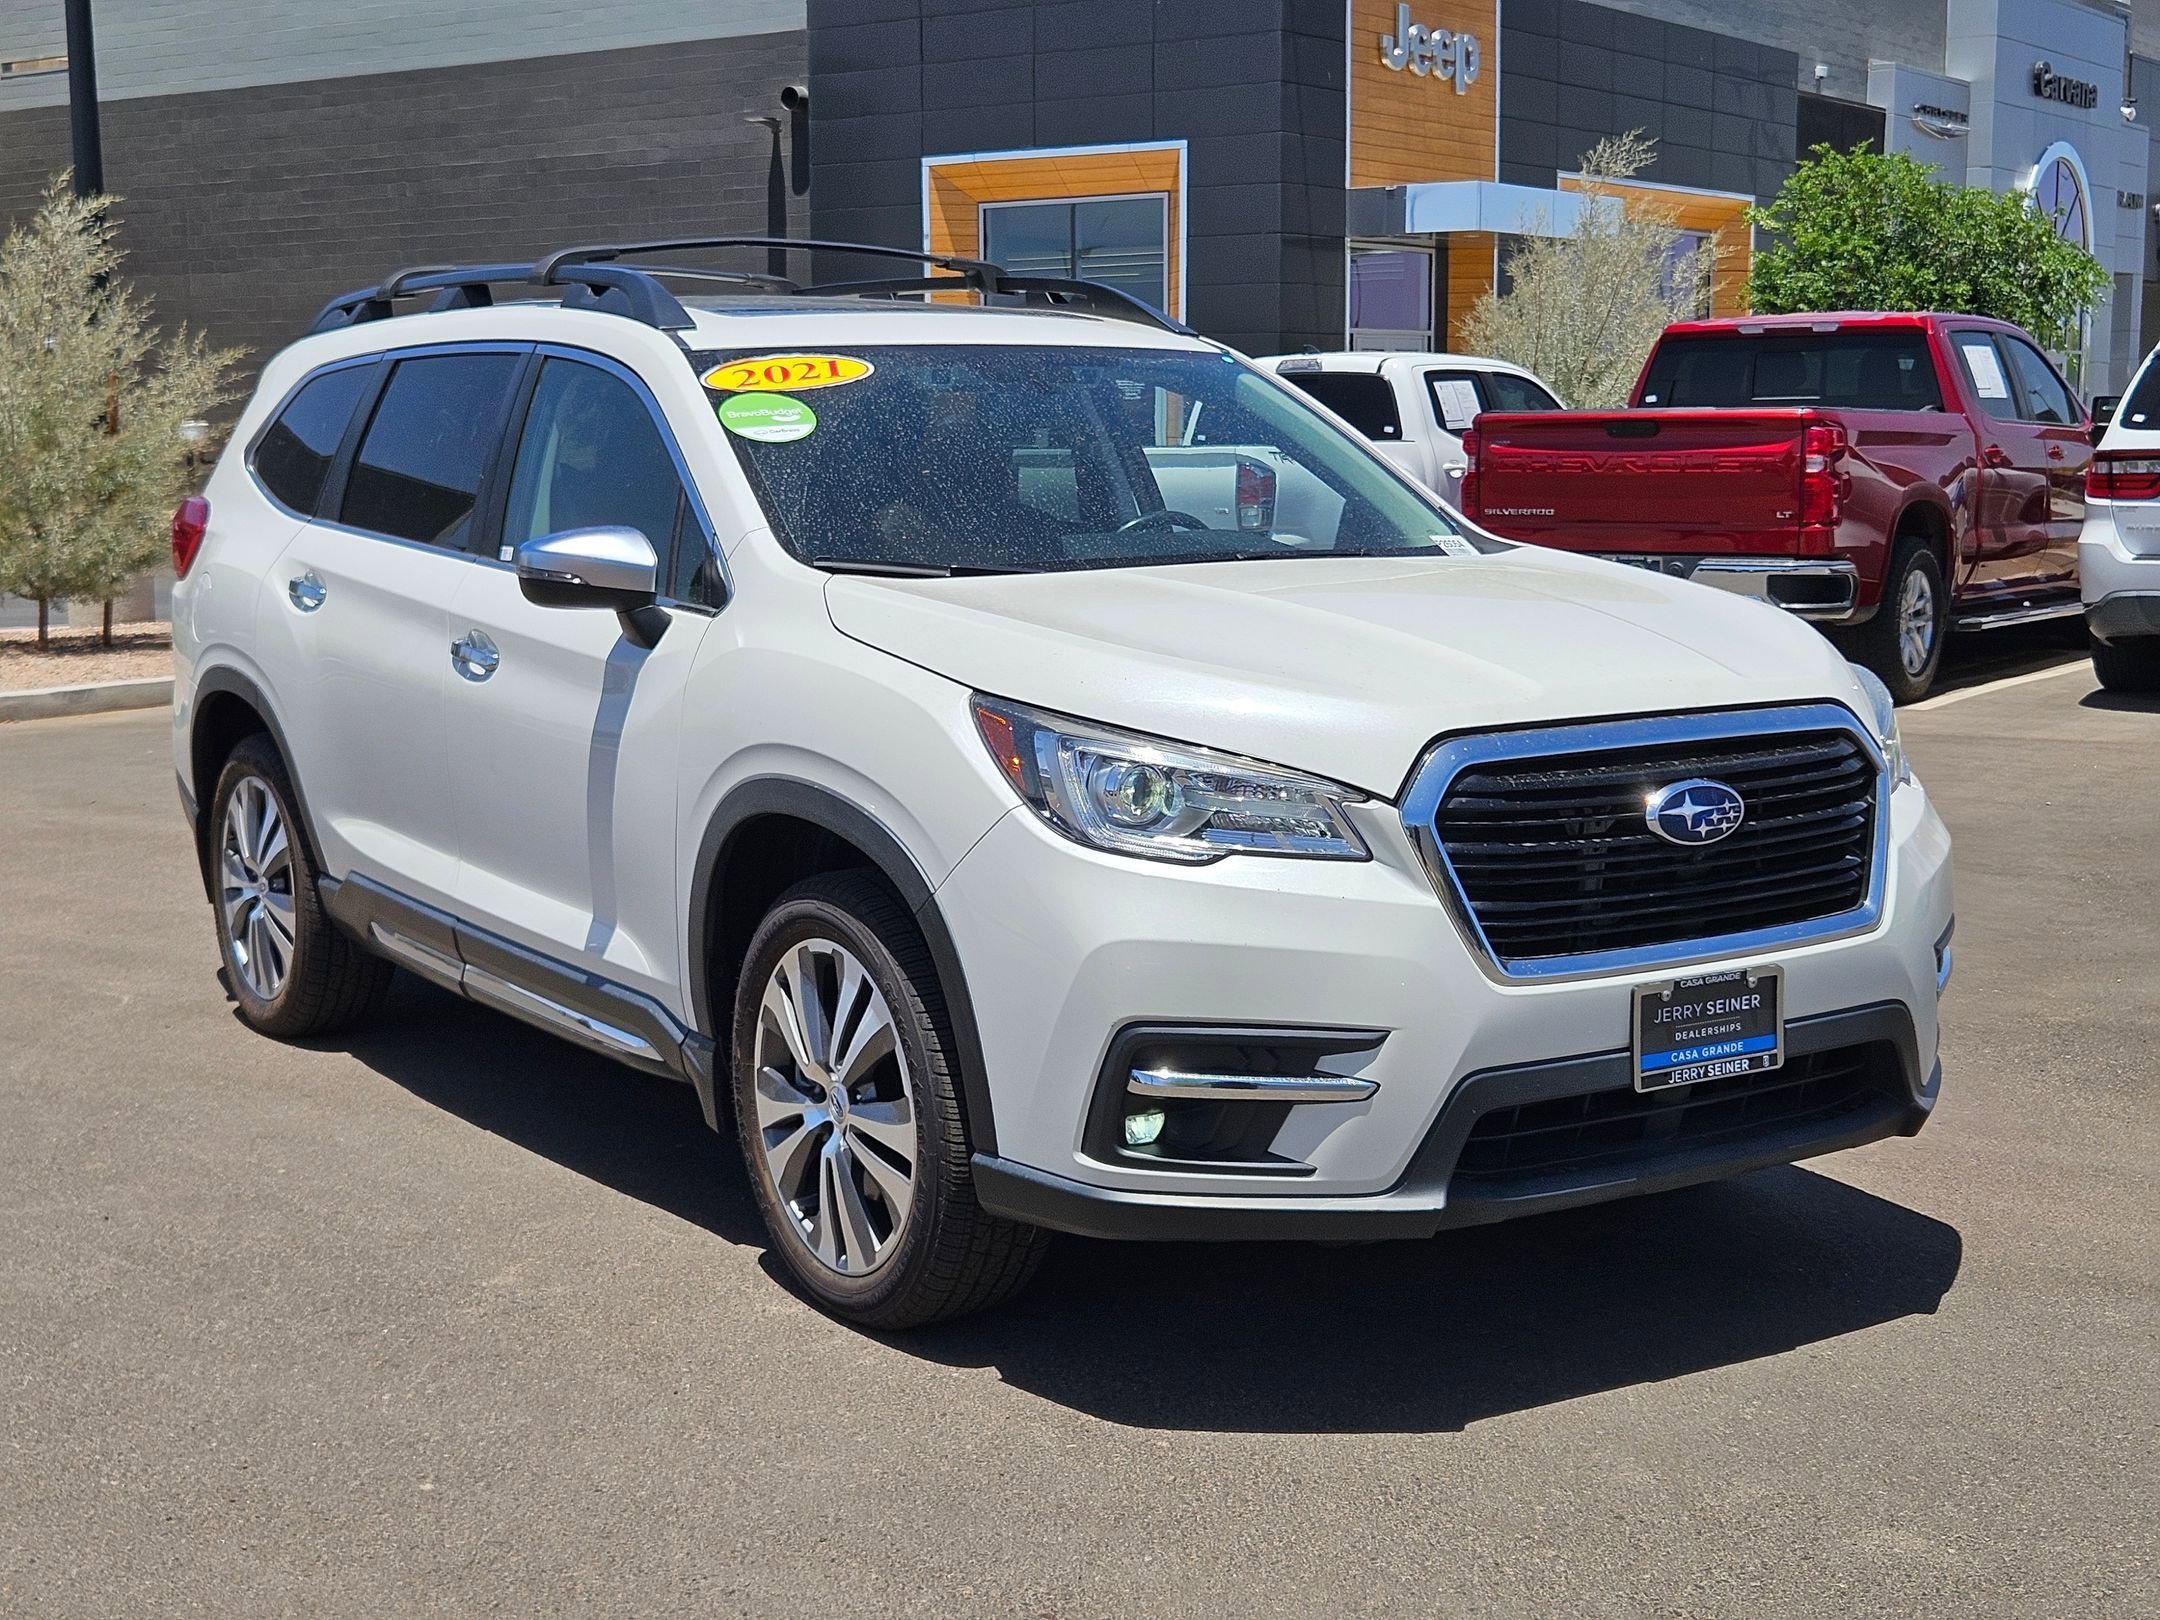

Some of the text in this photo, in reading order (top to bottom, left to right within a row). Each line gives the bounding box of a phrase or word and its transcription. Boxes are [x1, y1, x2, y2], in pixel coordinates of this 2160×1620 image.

[1379, 3, 1480, 96] Jeep
[2033, 61, 2098, 109] Carvana
[732, 360, 847, 388] 2021
[1484, 508, 1555, 516] SILVERADO
[1776, 511, 1793, 519] LT
[1680, 972, 1741, 989] CASA GRANDE
[1654, 994, 1761, 1024] JERRY SEINER
[1675, 1022, 1742, 1041] DEALERSHIPS
[1671, 1041, 1744, 1062] CASA GRANDE
[1668, 1059, 1750, 1084] JERRY SEINER
